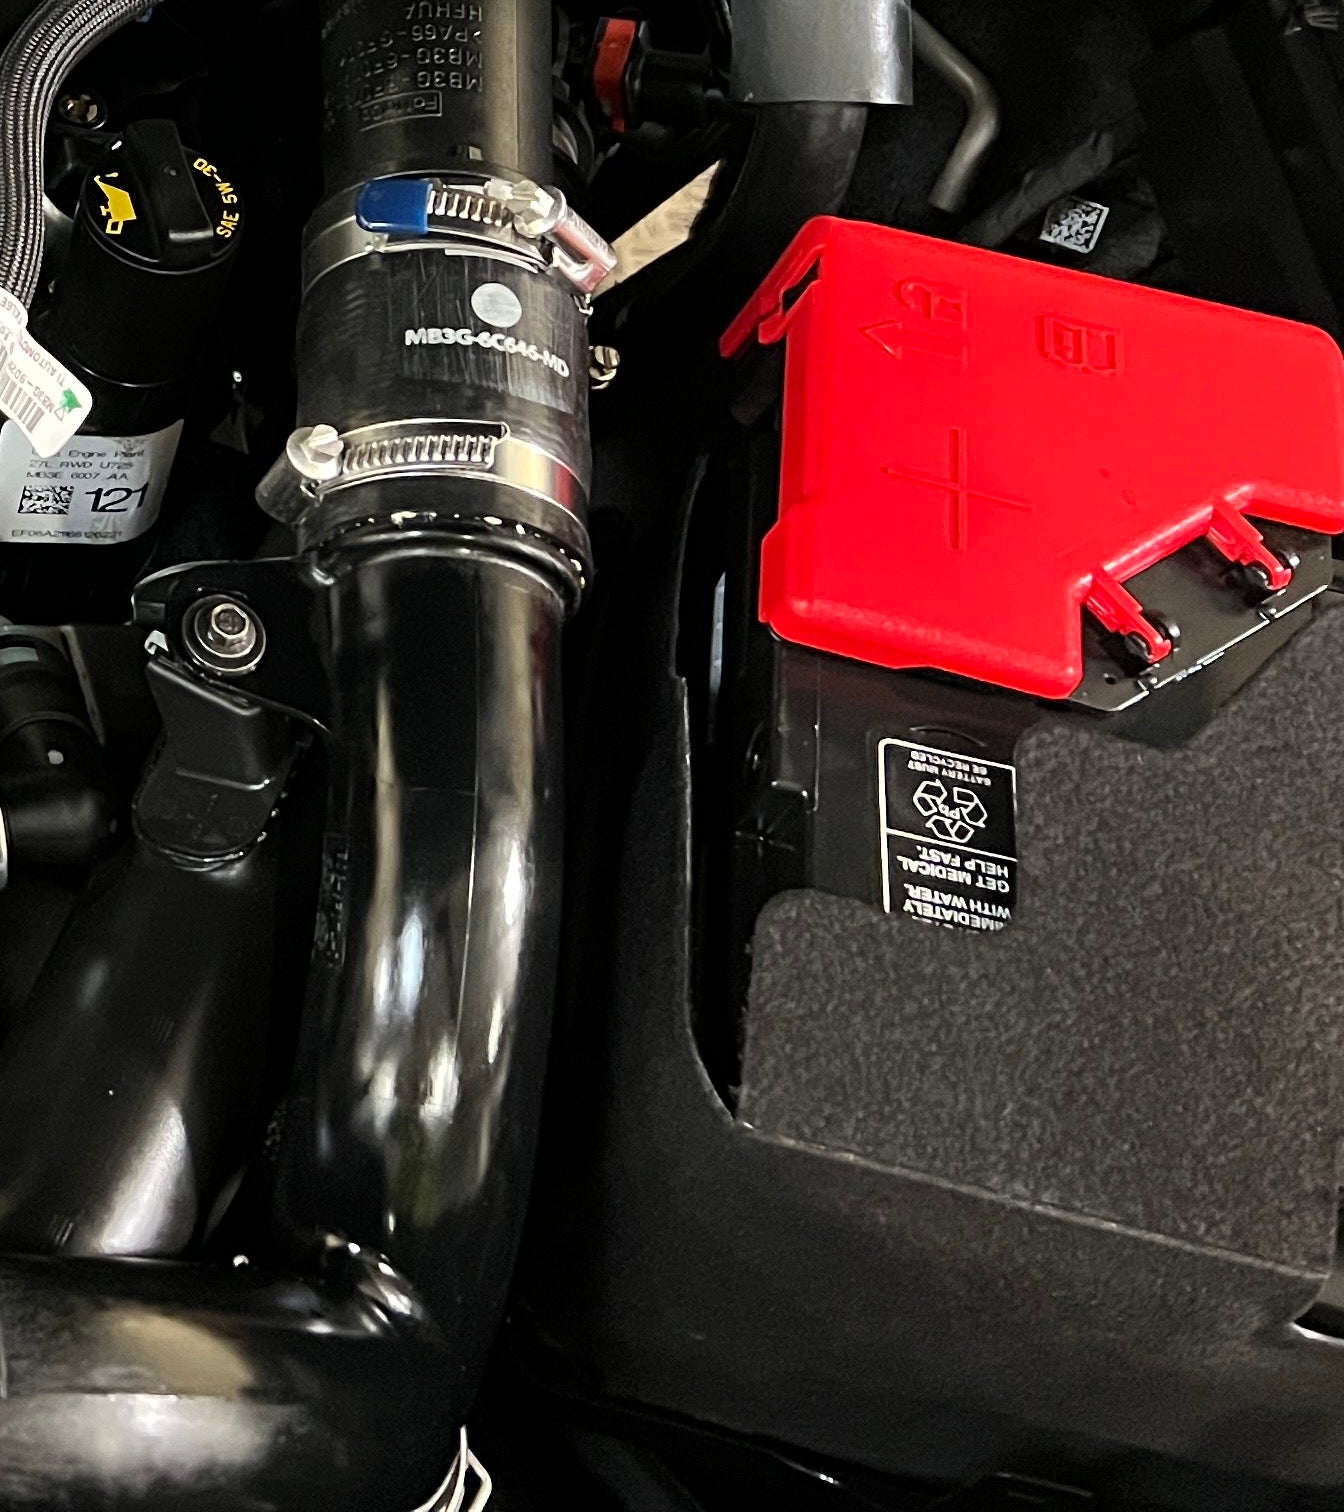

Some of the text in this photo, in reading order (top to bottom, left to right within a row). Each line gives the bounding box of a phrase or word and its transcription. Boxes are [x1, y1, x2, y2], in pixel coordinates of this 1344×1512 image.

[193, 158, 240, 238] SAE 5W-30
[85, 481, 150, 514] 121
[896, 855, 1010, 893] GET MEDICAL
[916, 845, 1009, 879] HELP FAST.
[903, 883, 1012, 920] WITH WATER.
